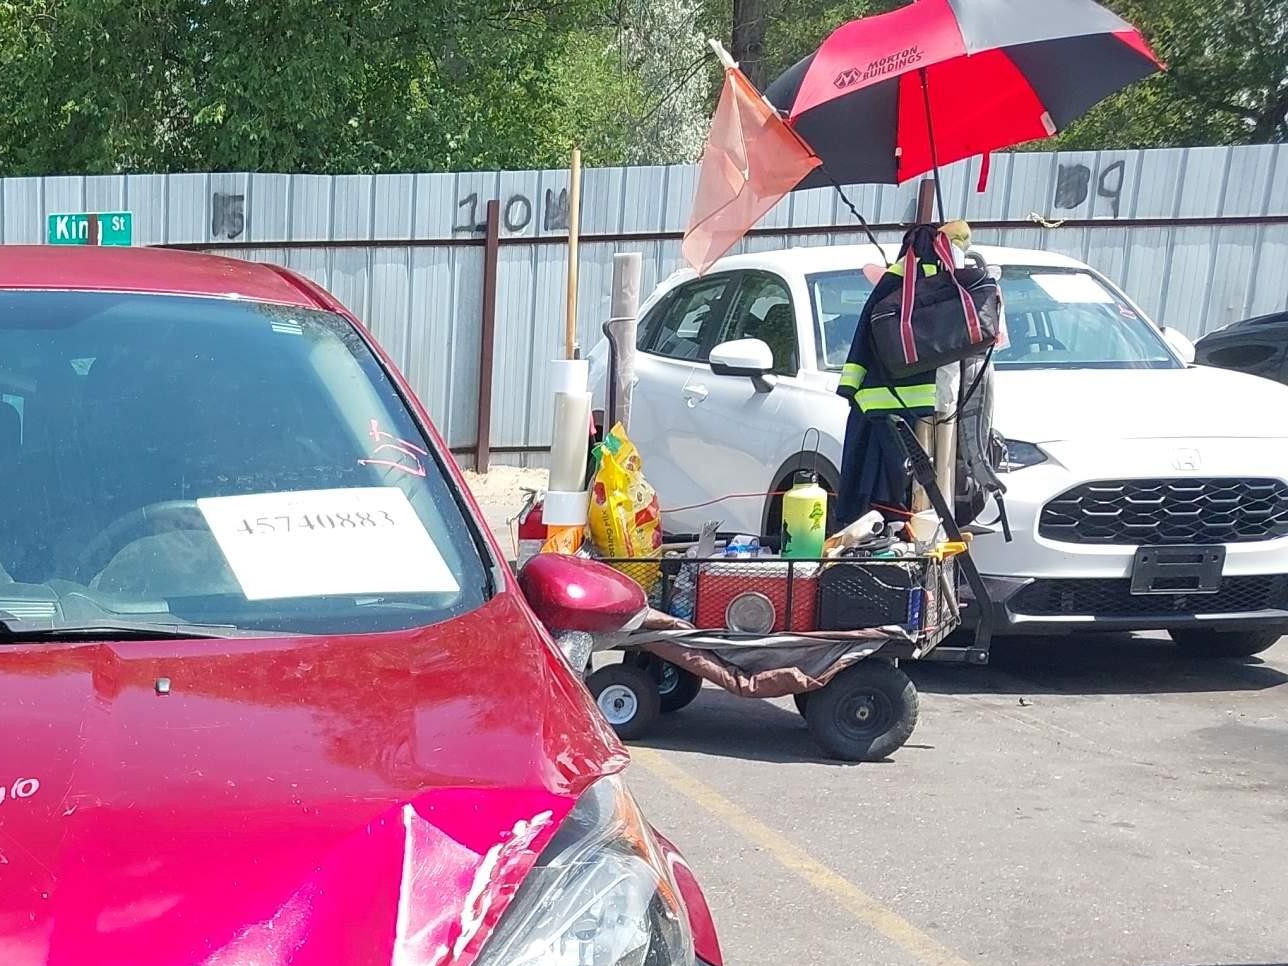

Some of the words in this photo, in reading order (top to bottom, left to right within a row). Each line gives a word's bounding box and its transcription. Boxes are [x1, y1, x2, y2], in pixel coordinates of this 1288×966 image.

[863, 52, 922, 80] BUILDINGS
[867, 45, 918, 71] MORTON
[112, 216, 125, 231] St
[453, 193, 532, 232] 10
